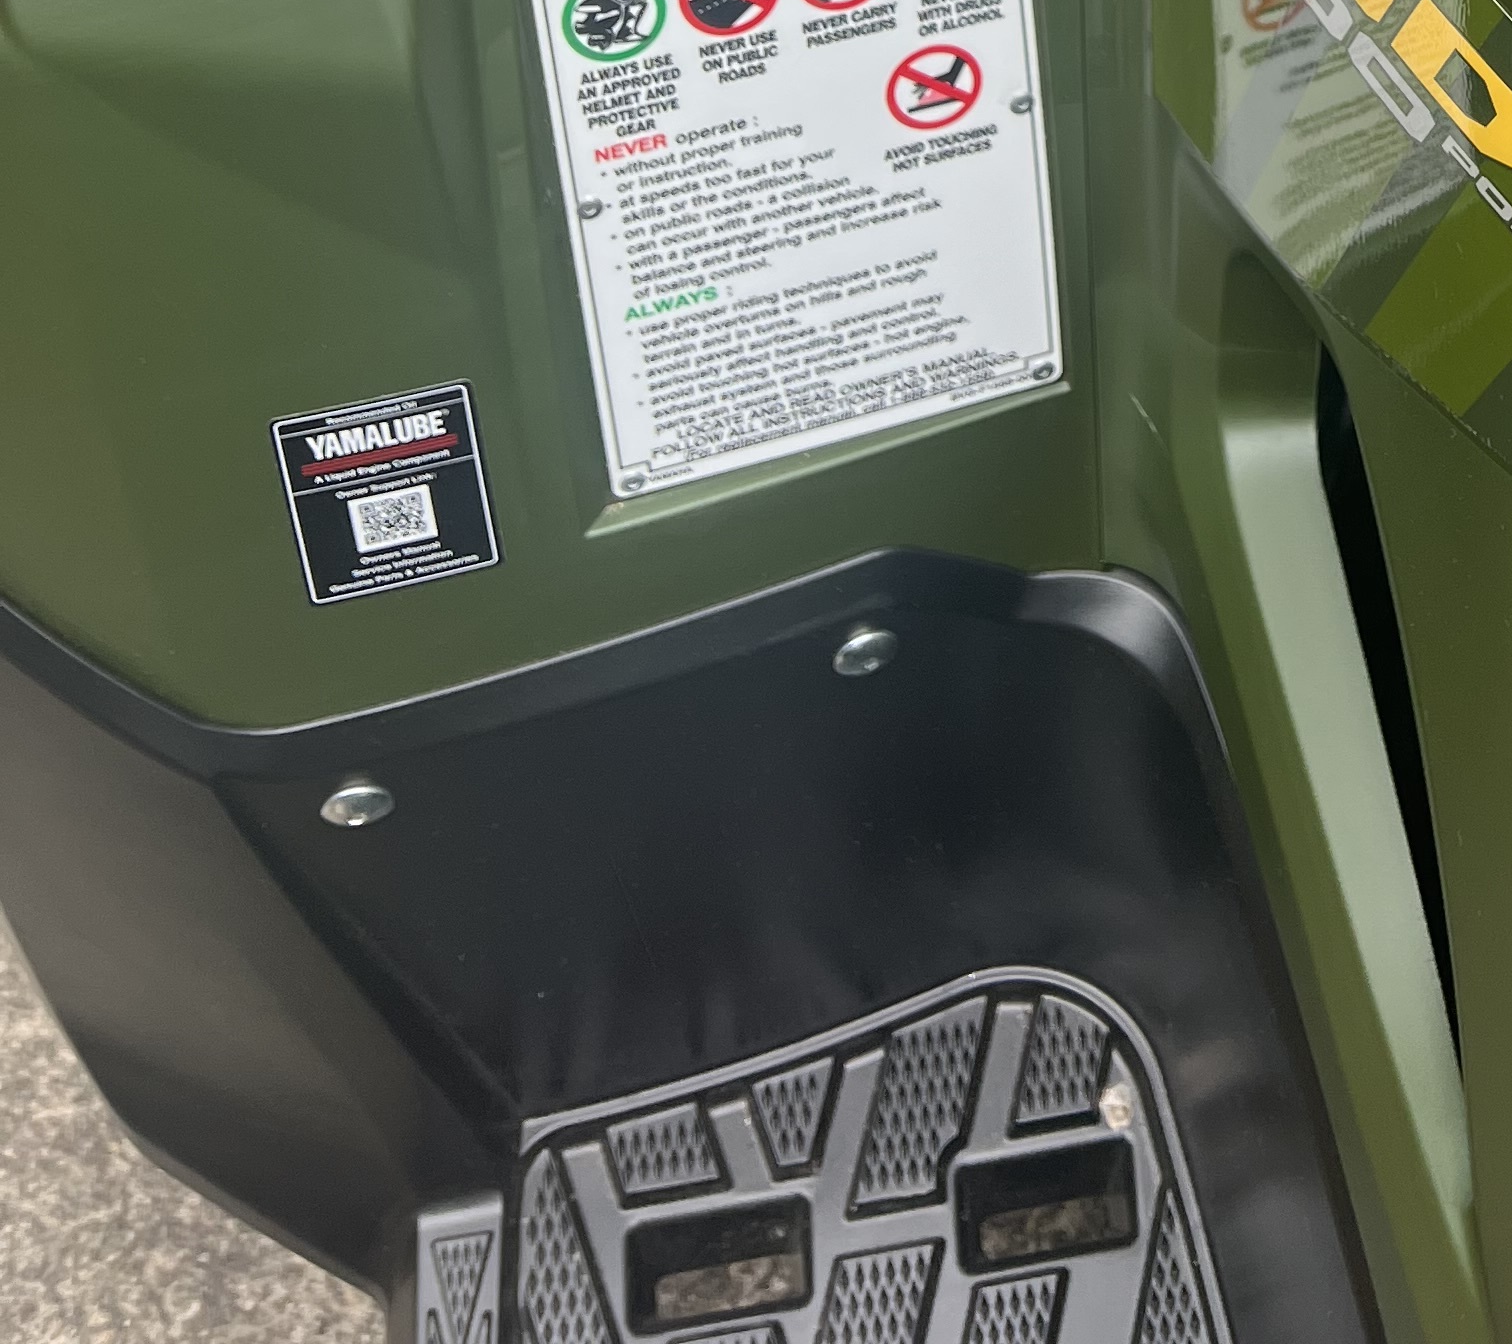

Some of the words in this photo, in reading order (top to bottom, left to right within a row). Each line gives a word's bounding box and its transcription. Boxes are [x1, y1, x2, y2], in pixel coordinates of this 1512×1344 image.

[801, 12, 849, 35] NEVER
[849, 1, 898, 25] CARRY
[805, 16, 897, 48] PASSENGERS
[698, 36, 746, 58] NEVER
[747, 28, 778, 48] USE
[701, 56, 724, 73] ON
[725, 43, 778, 67] PUBLIC
[575, 85, 598, 101] AN
[599, 66, 681, 96] APPROVED
[579, 60, 640, 85] ALWAYS
[642, 52, 673, 72] USE
[717, 61, 766, 84] ROADS
[581, 90, 642, 115] HELMET
[643, 82, 676, 101] AND
[586, 96, 680, 129] PROTECTIVE
[593, 132, 668, 164] NEVER
[674, 117, 748, 147] operate
[614, 117, 656, 138] GEAR
[622, 285, 719, 322] ALWAYS
[304, 411, 448, 461] YAMALUBE
